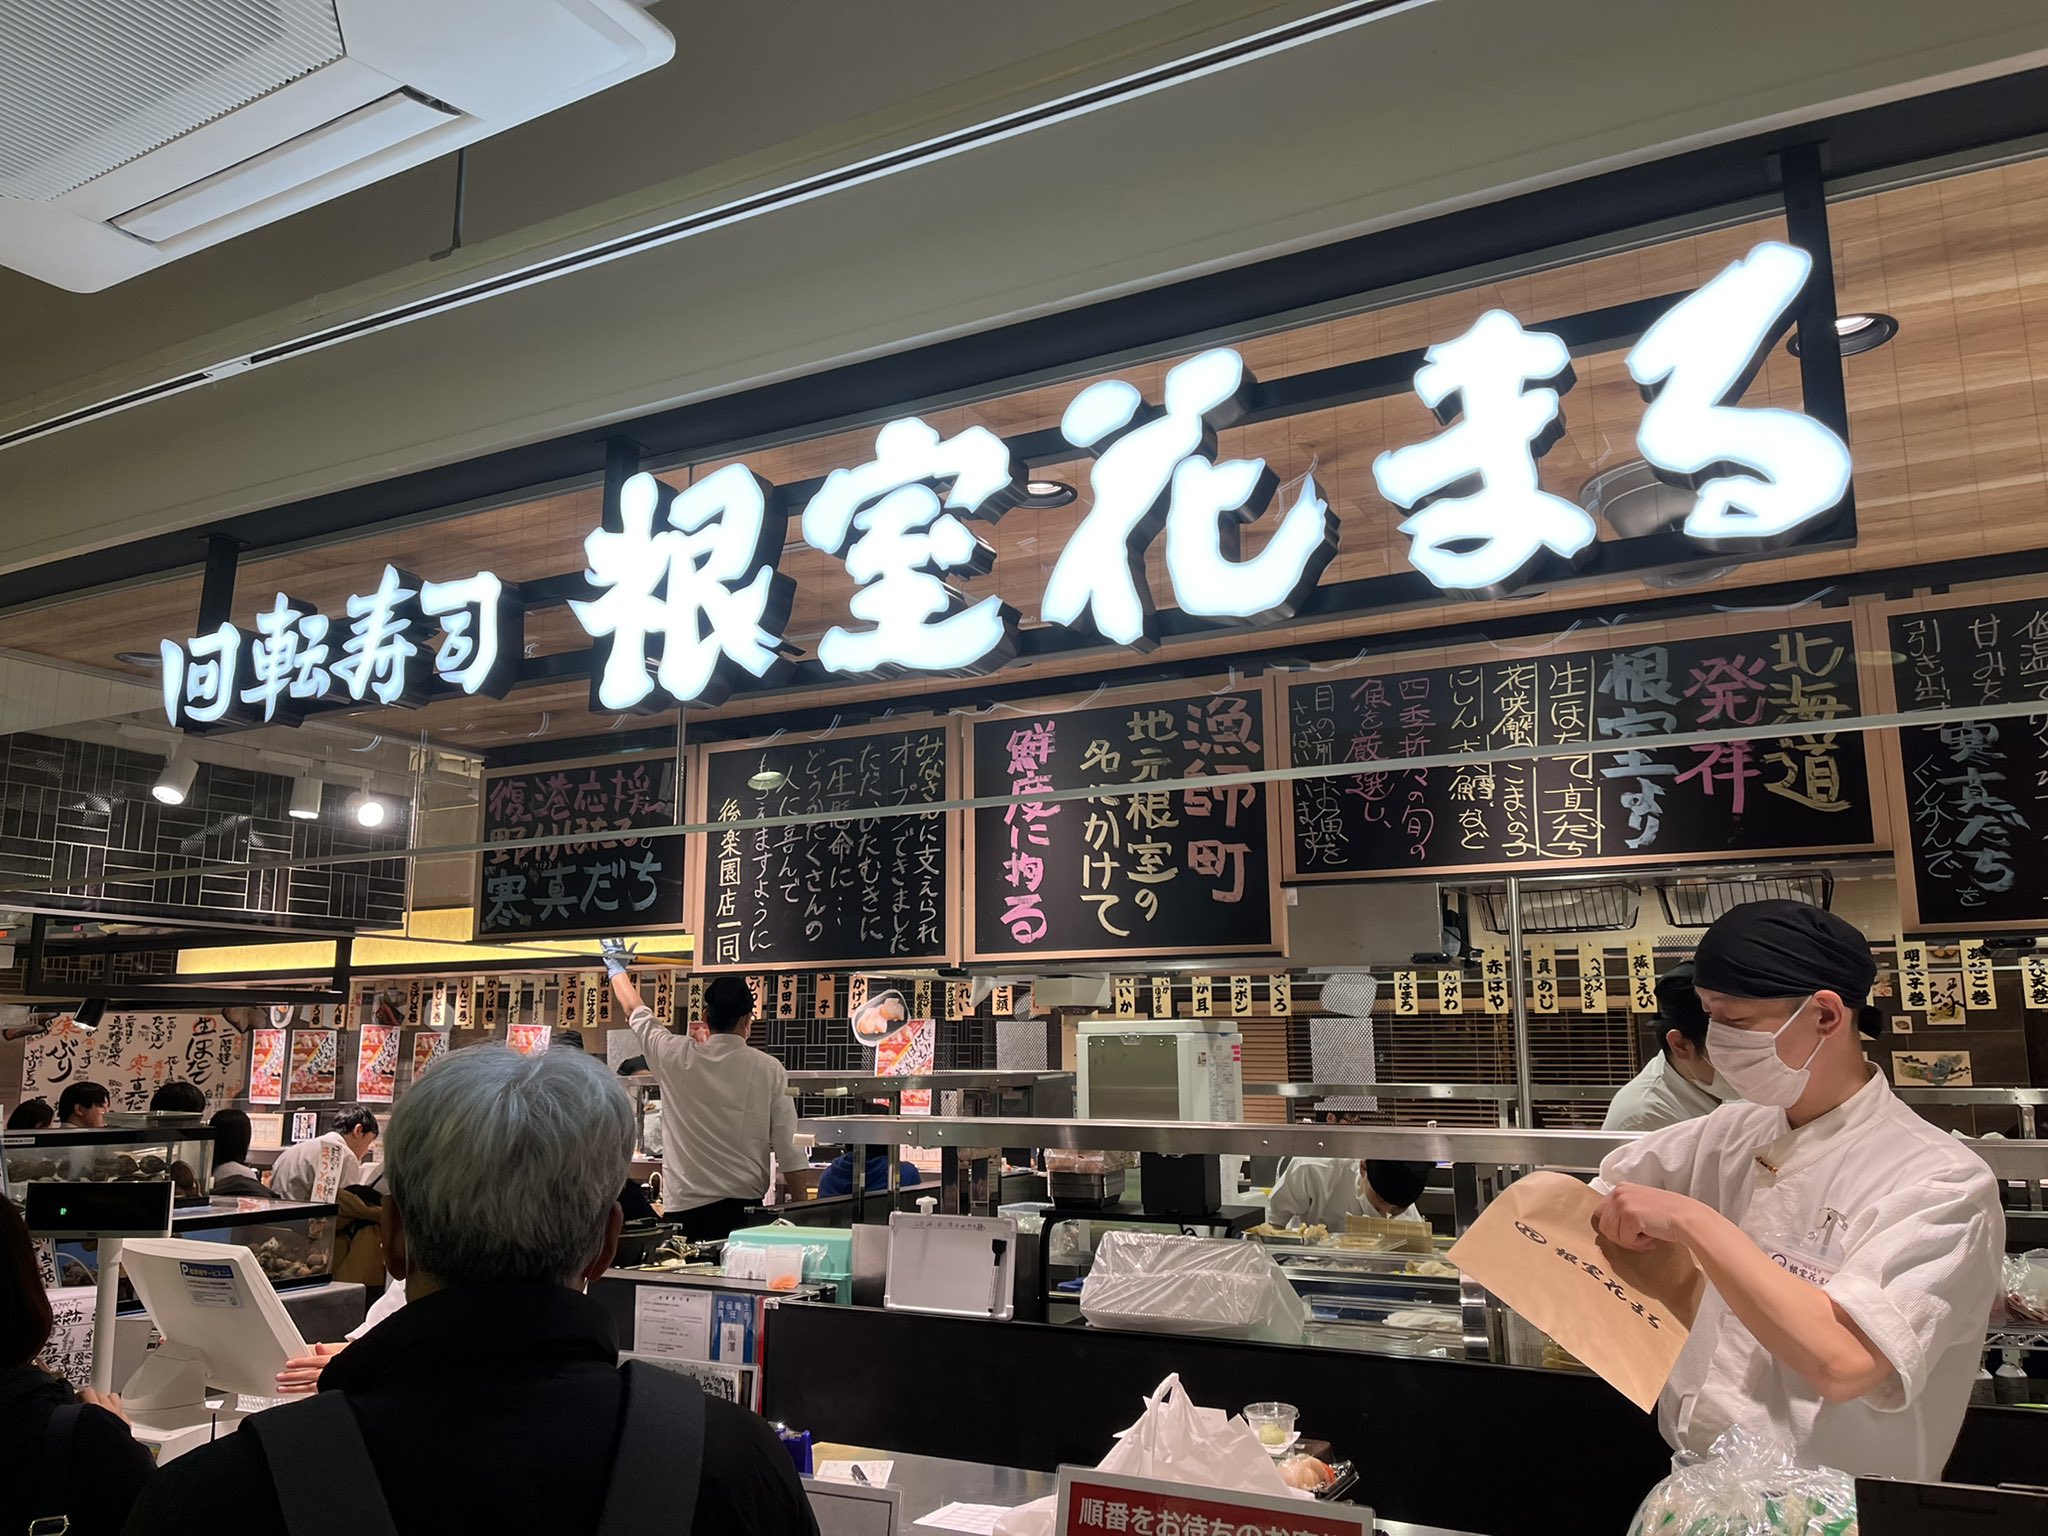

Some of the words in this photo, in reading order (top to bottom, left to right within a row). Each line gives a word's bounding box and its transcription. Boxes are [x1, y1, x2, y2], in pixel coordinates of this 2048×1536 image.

[567, 241, 1853, 710] 根室花まる
[161, 563, 503, 728] 回転寿司
[1763, 631, 1852, 812] 北海道
[1125, 709, 1180, 921] 地元根室の
[1182, 696, 1261, 903] 漁師町
[1291, 700, 1321, 865] さばいいます
[1597, 646, 1682, 849] 根室より
[1674, 654, 1768, 814] 発祥
[715, 797, 743, 964] 後楽園店一同
[772, 765, 803, 903] 人に喜んで
[1000, 720, 1062, 944] 鮮度に拘る
[1079, 739, 1131, 937] 名にかけて
[1486, 957, 1505, 1011] 赤ほや
[1537, 957, 1554, 1010] 真あじ
[1904, 948, 1927, 1006] 明太子巻
[1554, 1247, 1662, 1330] 根室花まる
[1789, 1264, 1830, 1285] 根室花ま
